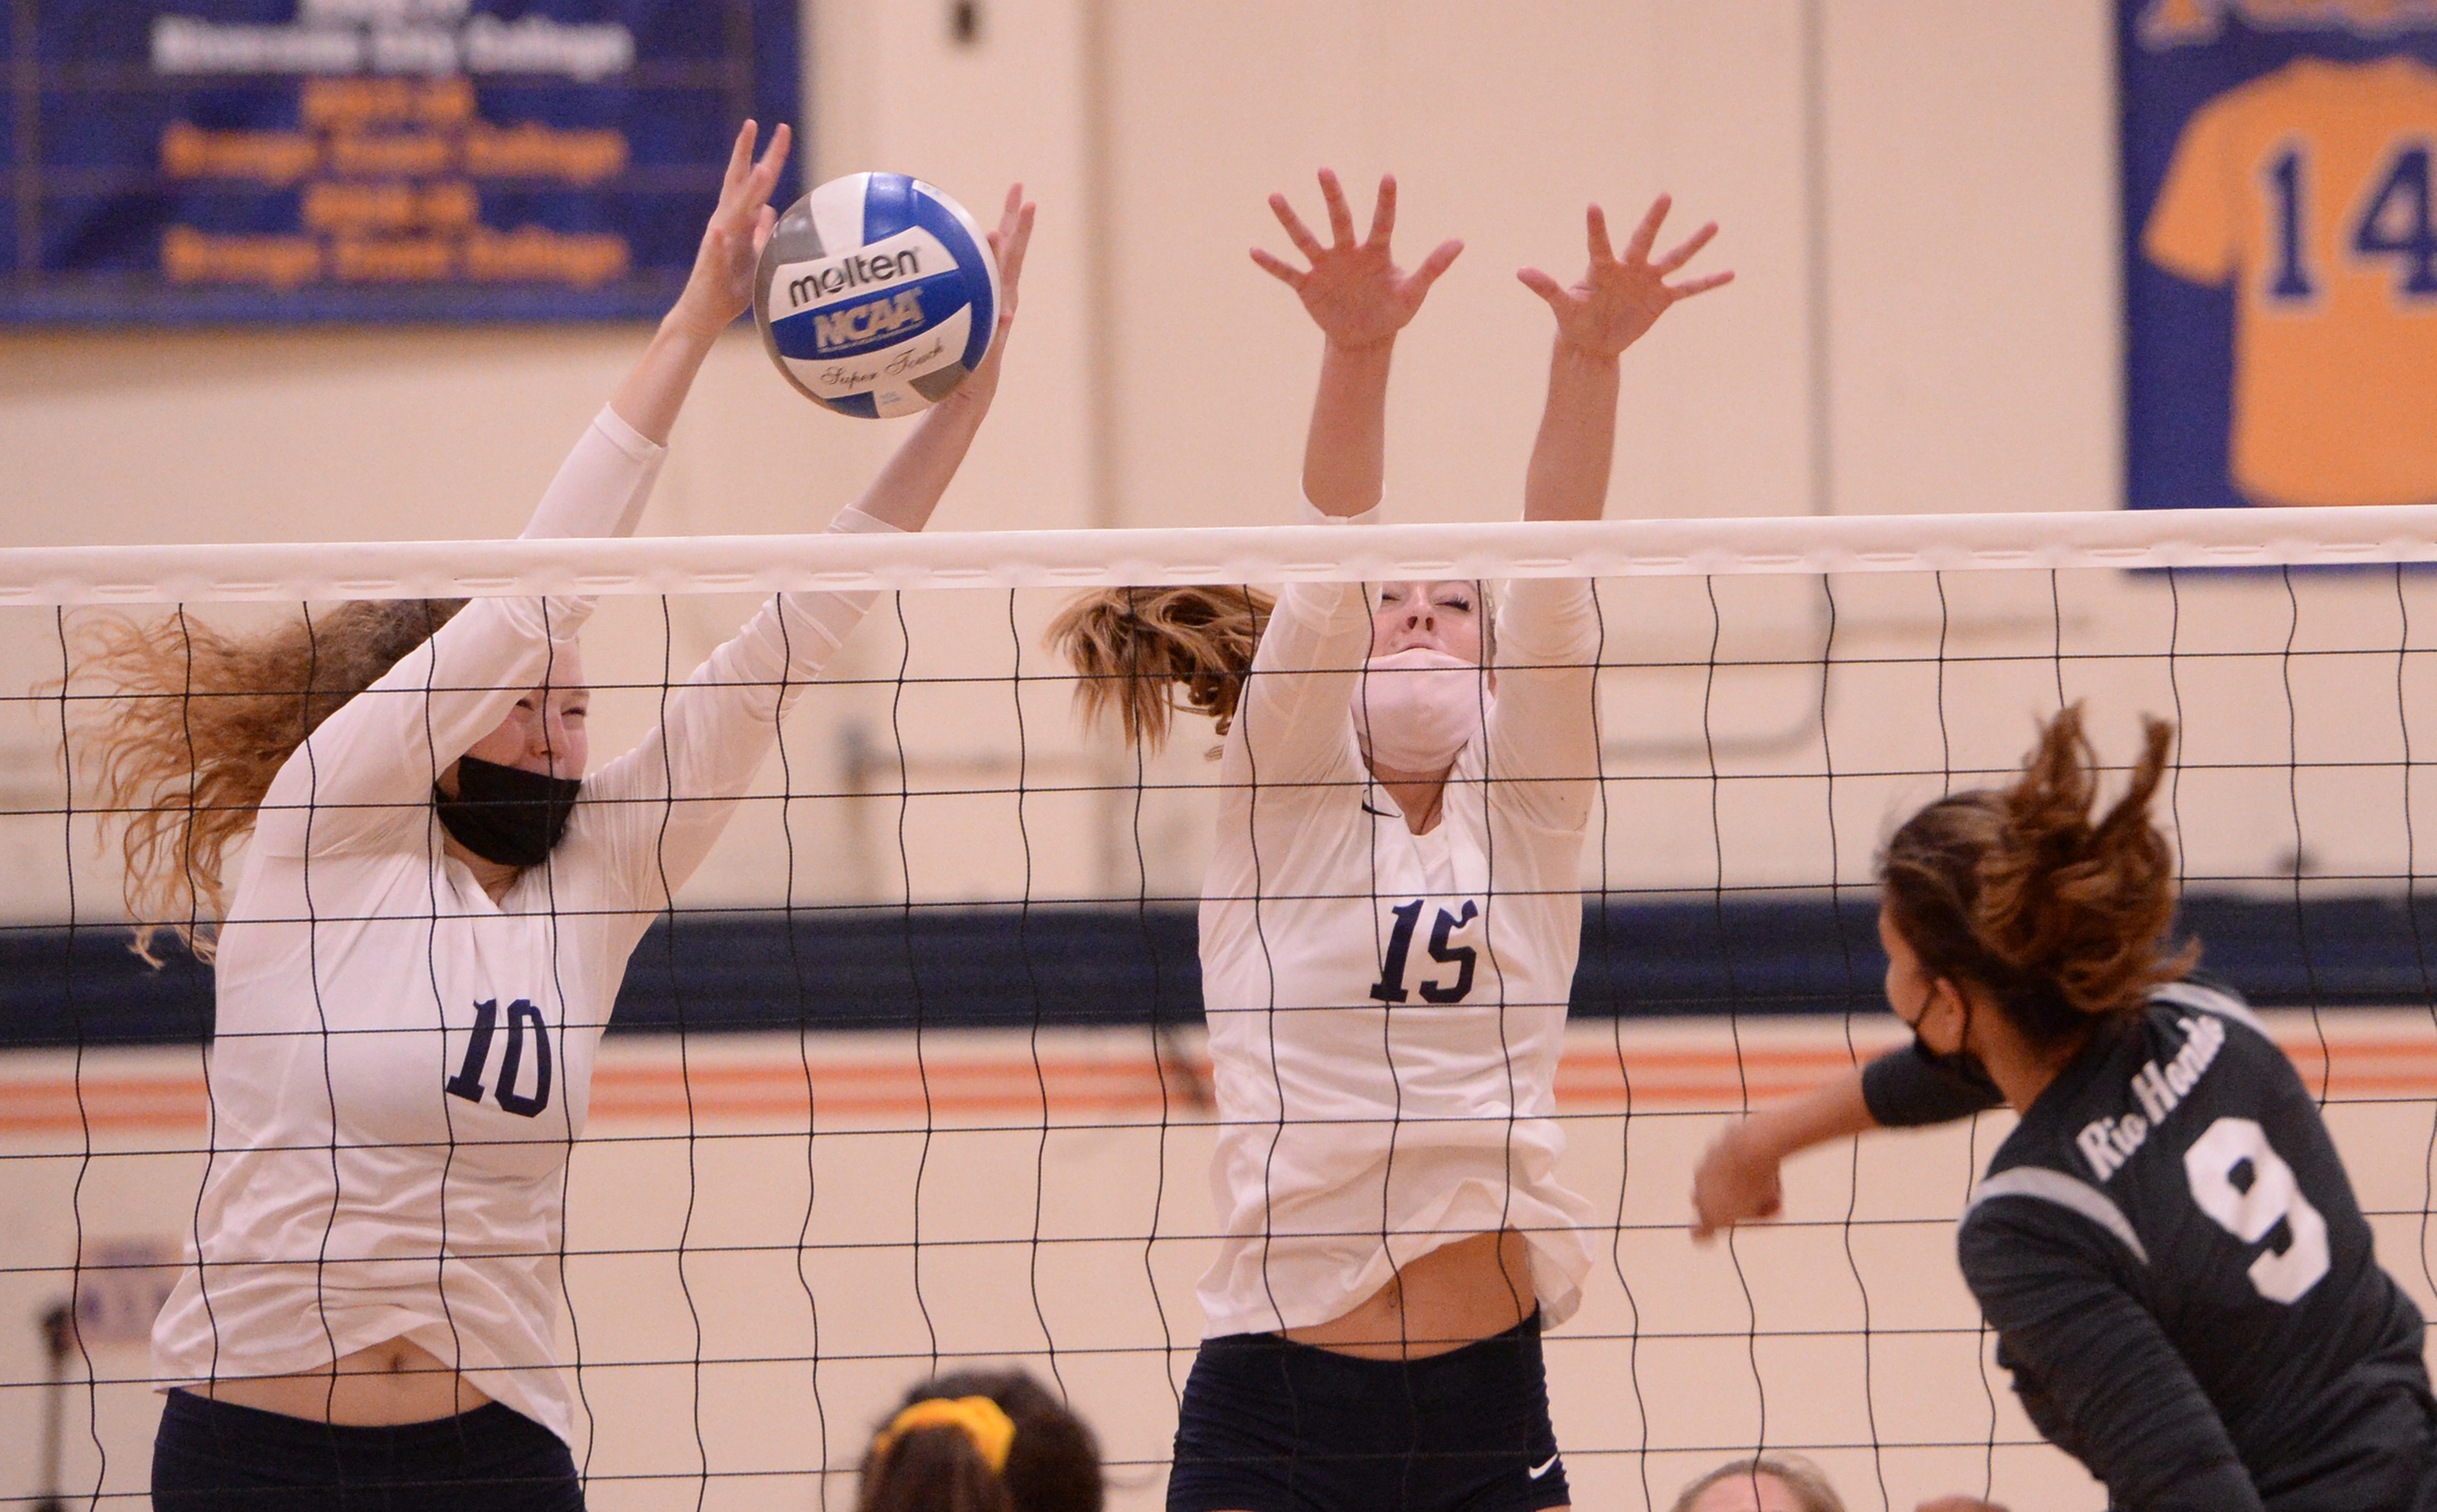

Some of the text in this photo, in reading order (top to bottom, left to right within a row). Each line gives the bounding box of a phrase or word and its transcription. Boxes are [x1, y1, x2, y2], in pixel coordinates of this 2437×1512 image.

[2258, 138, 2437, 308] 14
[789, 250, 920, 307] molten
[814, 287, 925, 349] NCAA
[820, 365, 879, 390] Super
[1369, 899, 1478, 1003] 15
[446, 998, 552, 1118] 10
[2076, 1112, 2148, 1182] Rio
[2184, 1116, 2331, 1305] 9
